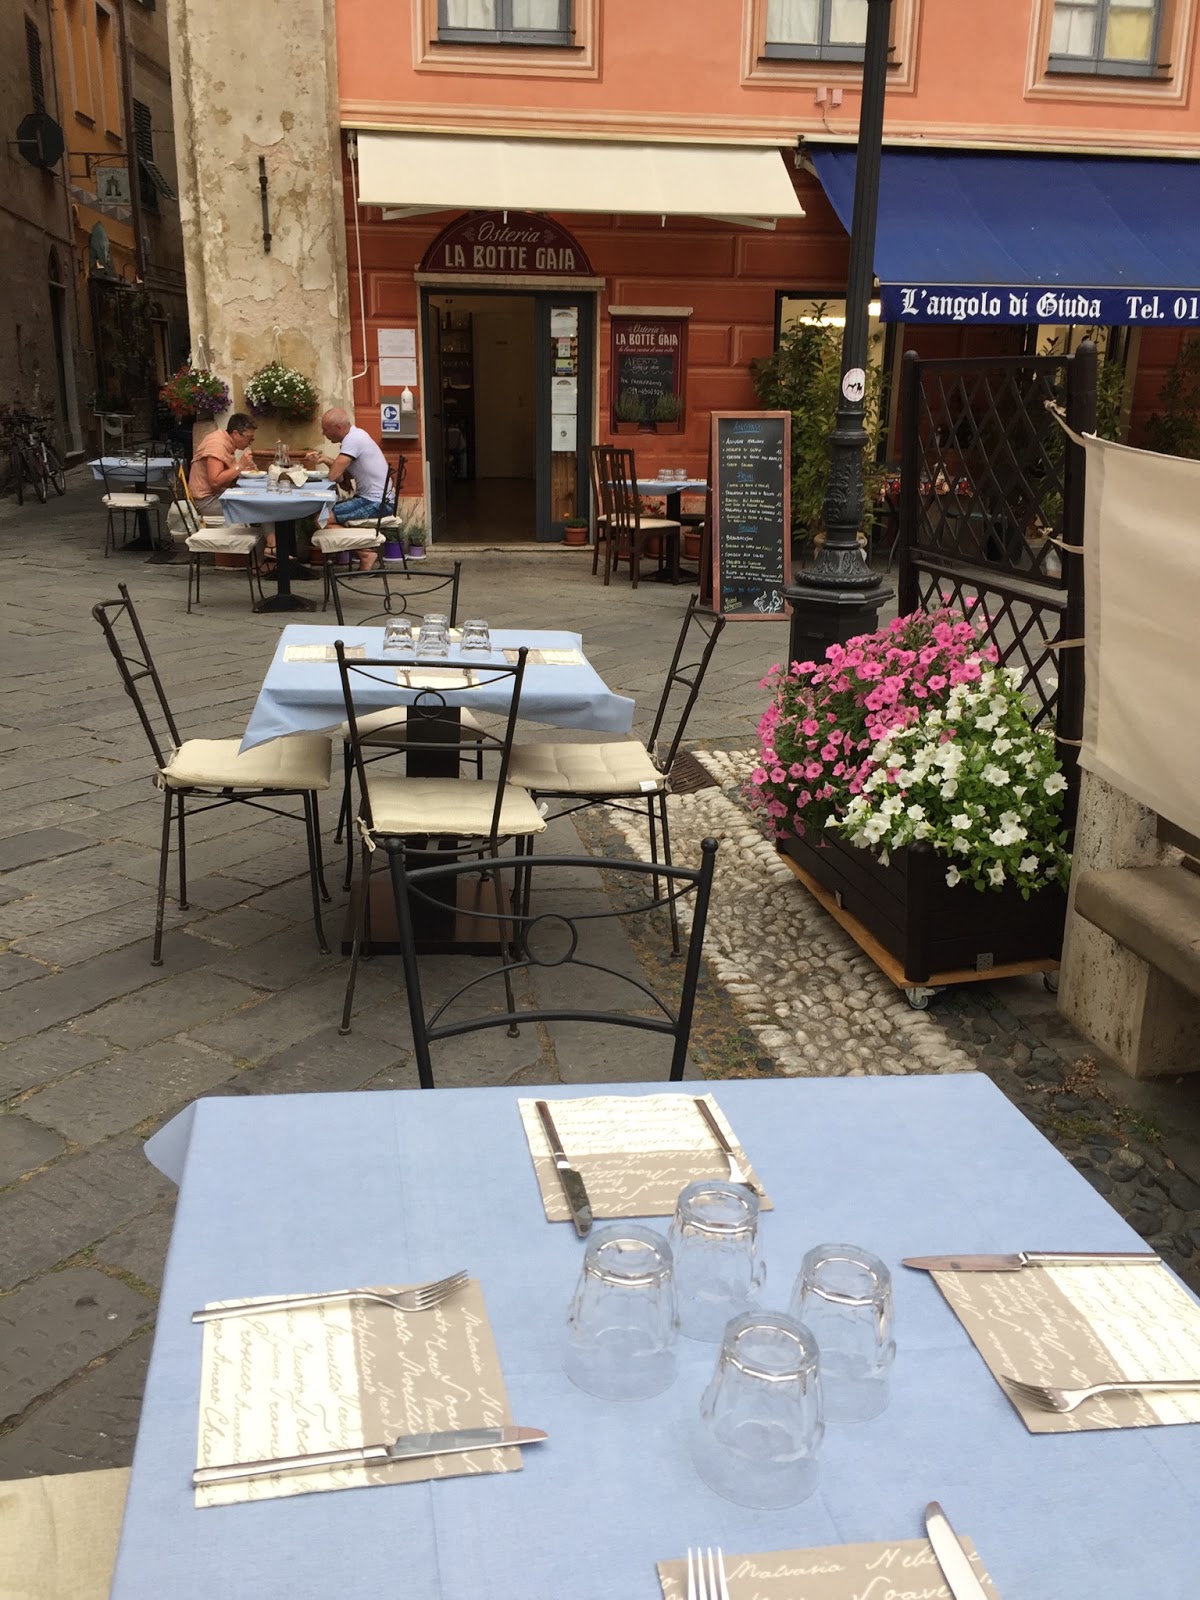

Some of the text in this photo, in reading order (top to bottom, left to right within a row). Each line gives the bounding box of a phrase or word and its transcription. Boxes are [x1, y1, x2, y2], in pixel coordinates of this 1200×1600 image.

[477, 220, 541, 243] Osteria
[445, 244, 576, 270] LA BOTTE GAIA
[901, 288, 1001, 321] L'angolo
[1008, 292, 1029, 317] di
[1036, 292, 1101, 318] Giuda
[1126, 296, 1165, 319] Tel.
[615, 333, 678, 346] LA BOTTE GAIA
[633, 323, 660, 334] Osteria
